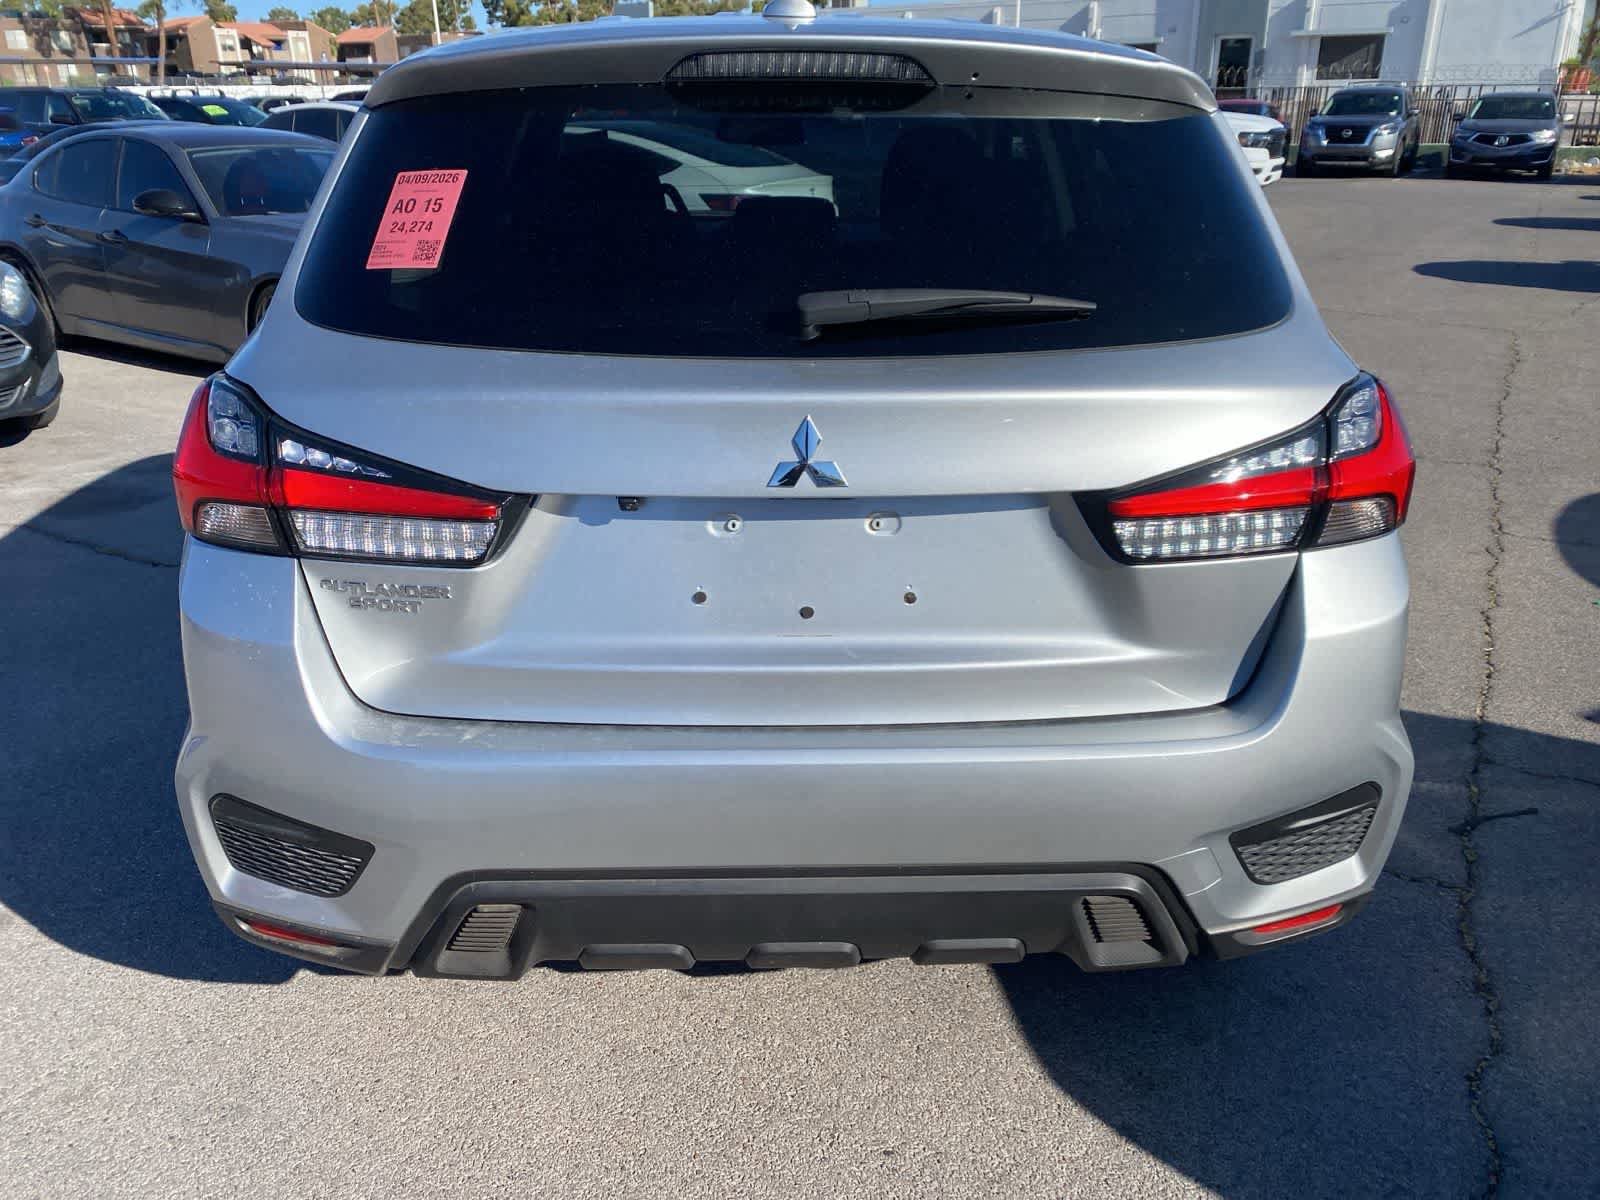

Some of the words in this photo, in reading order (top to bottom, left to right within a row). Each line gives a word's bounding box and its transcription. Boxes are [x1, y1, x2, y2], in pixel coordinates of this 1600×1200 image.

[398, 172, 460, 185] 04/09/2026
[423, 197, 444, 213] 15
[390, 220, 433, 234] 24,274
[320, 579, 452, 599] OUTLANDER
[349, 596, 424, 614] SPORT
